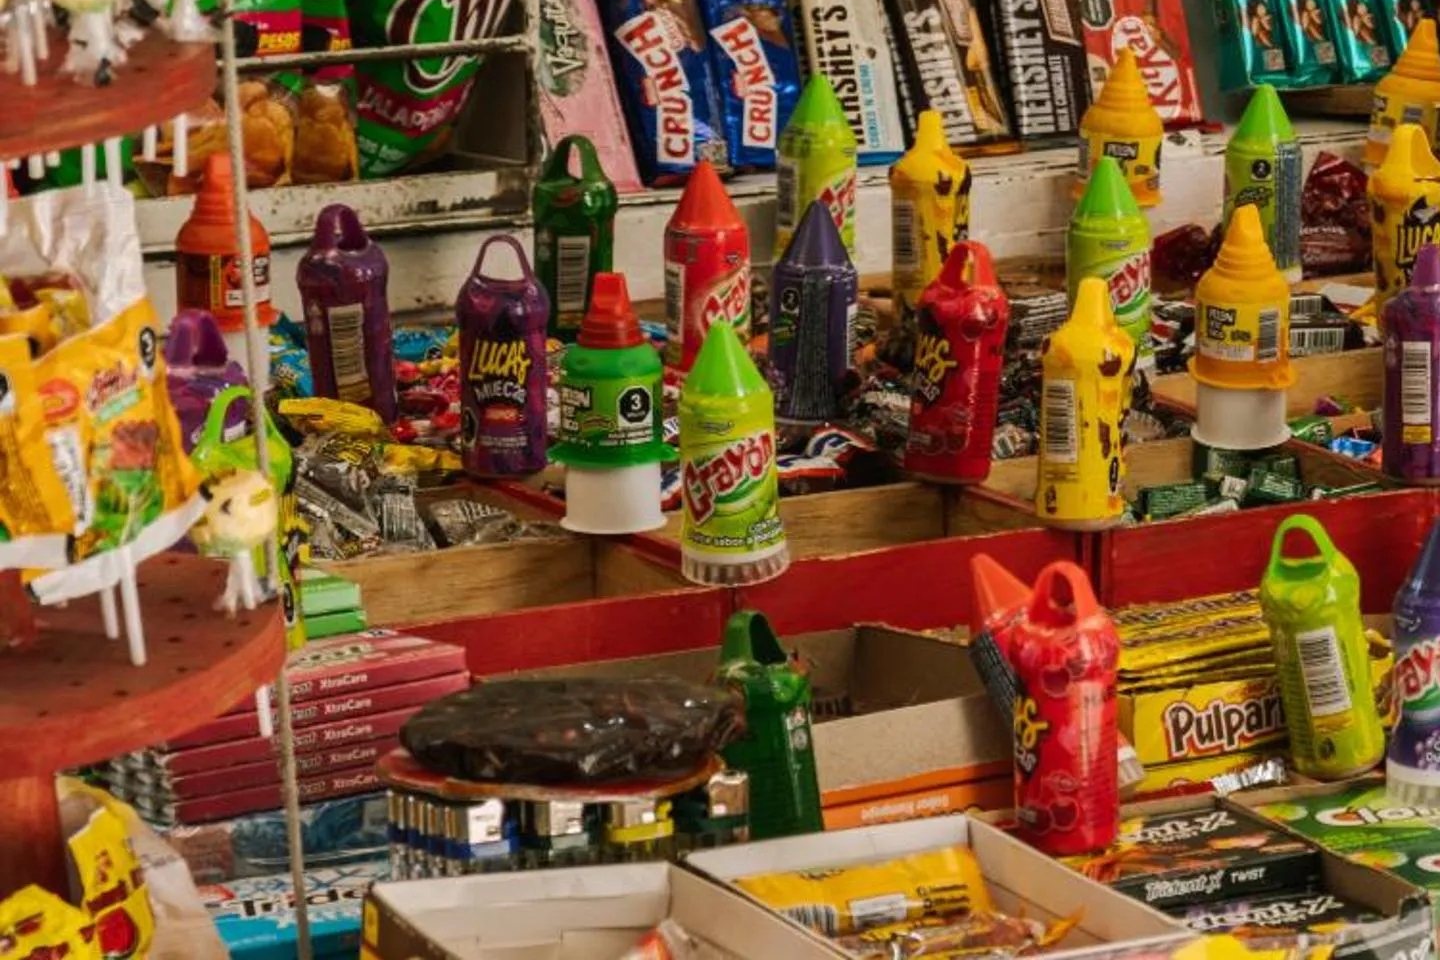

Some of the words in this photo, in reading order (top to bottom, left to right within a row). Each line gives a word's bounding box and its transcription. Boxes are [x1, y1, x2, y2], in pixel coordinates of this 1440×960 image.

[624, 17, 690, 158] CRUNCH
[722, 20, 774, 142] CRUNCH
[468, 339, 532, 381] LUCAS
[629, 393, 642, 411] 3
[683, 431, 775, 525] Crayón
[1230, 867, 1267, 884] TWIST
